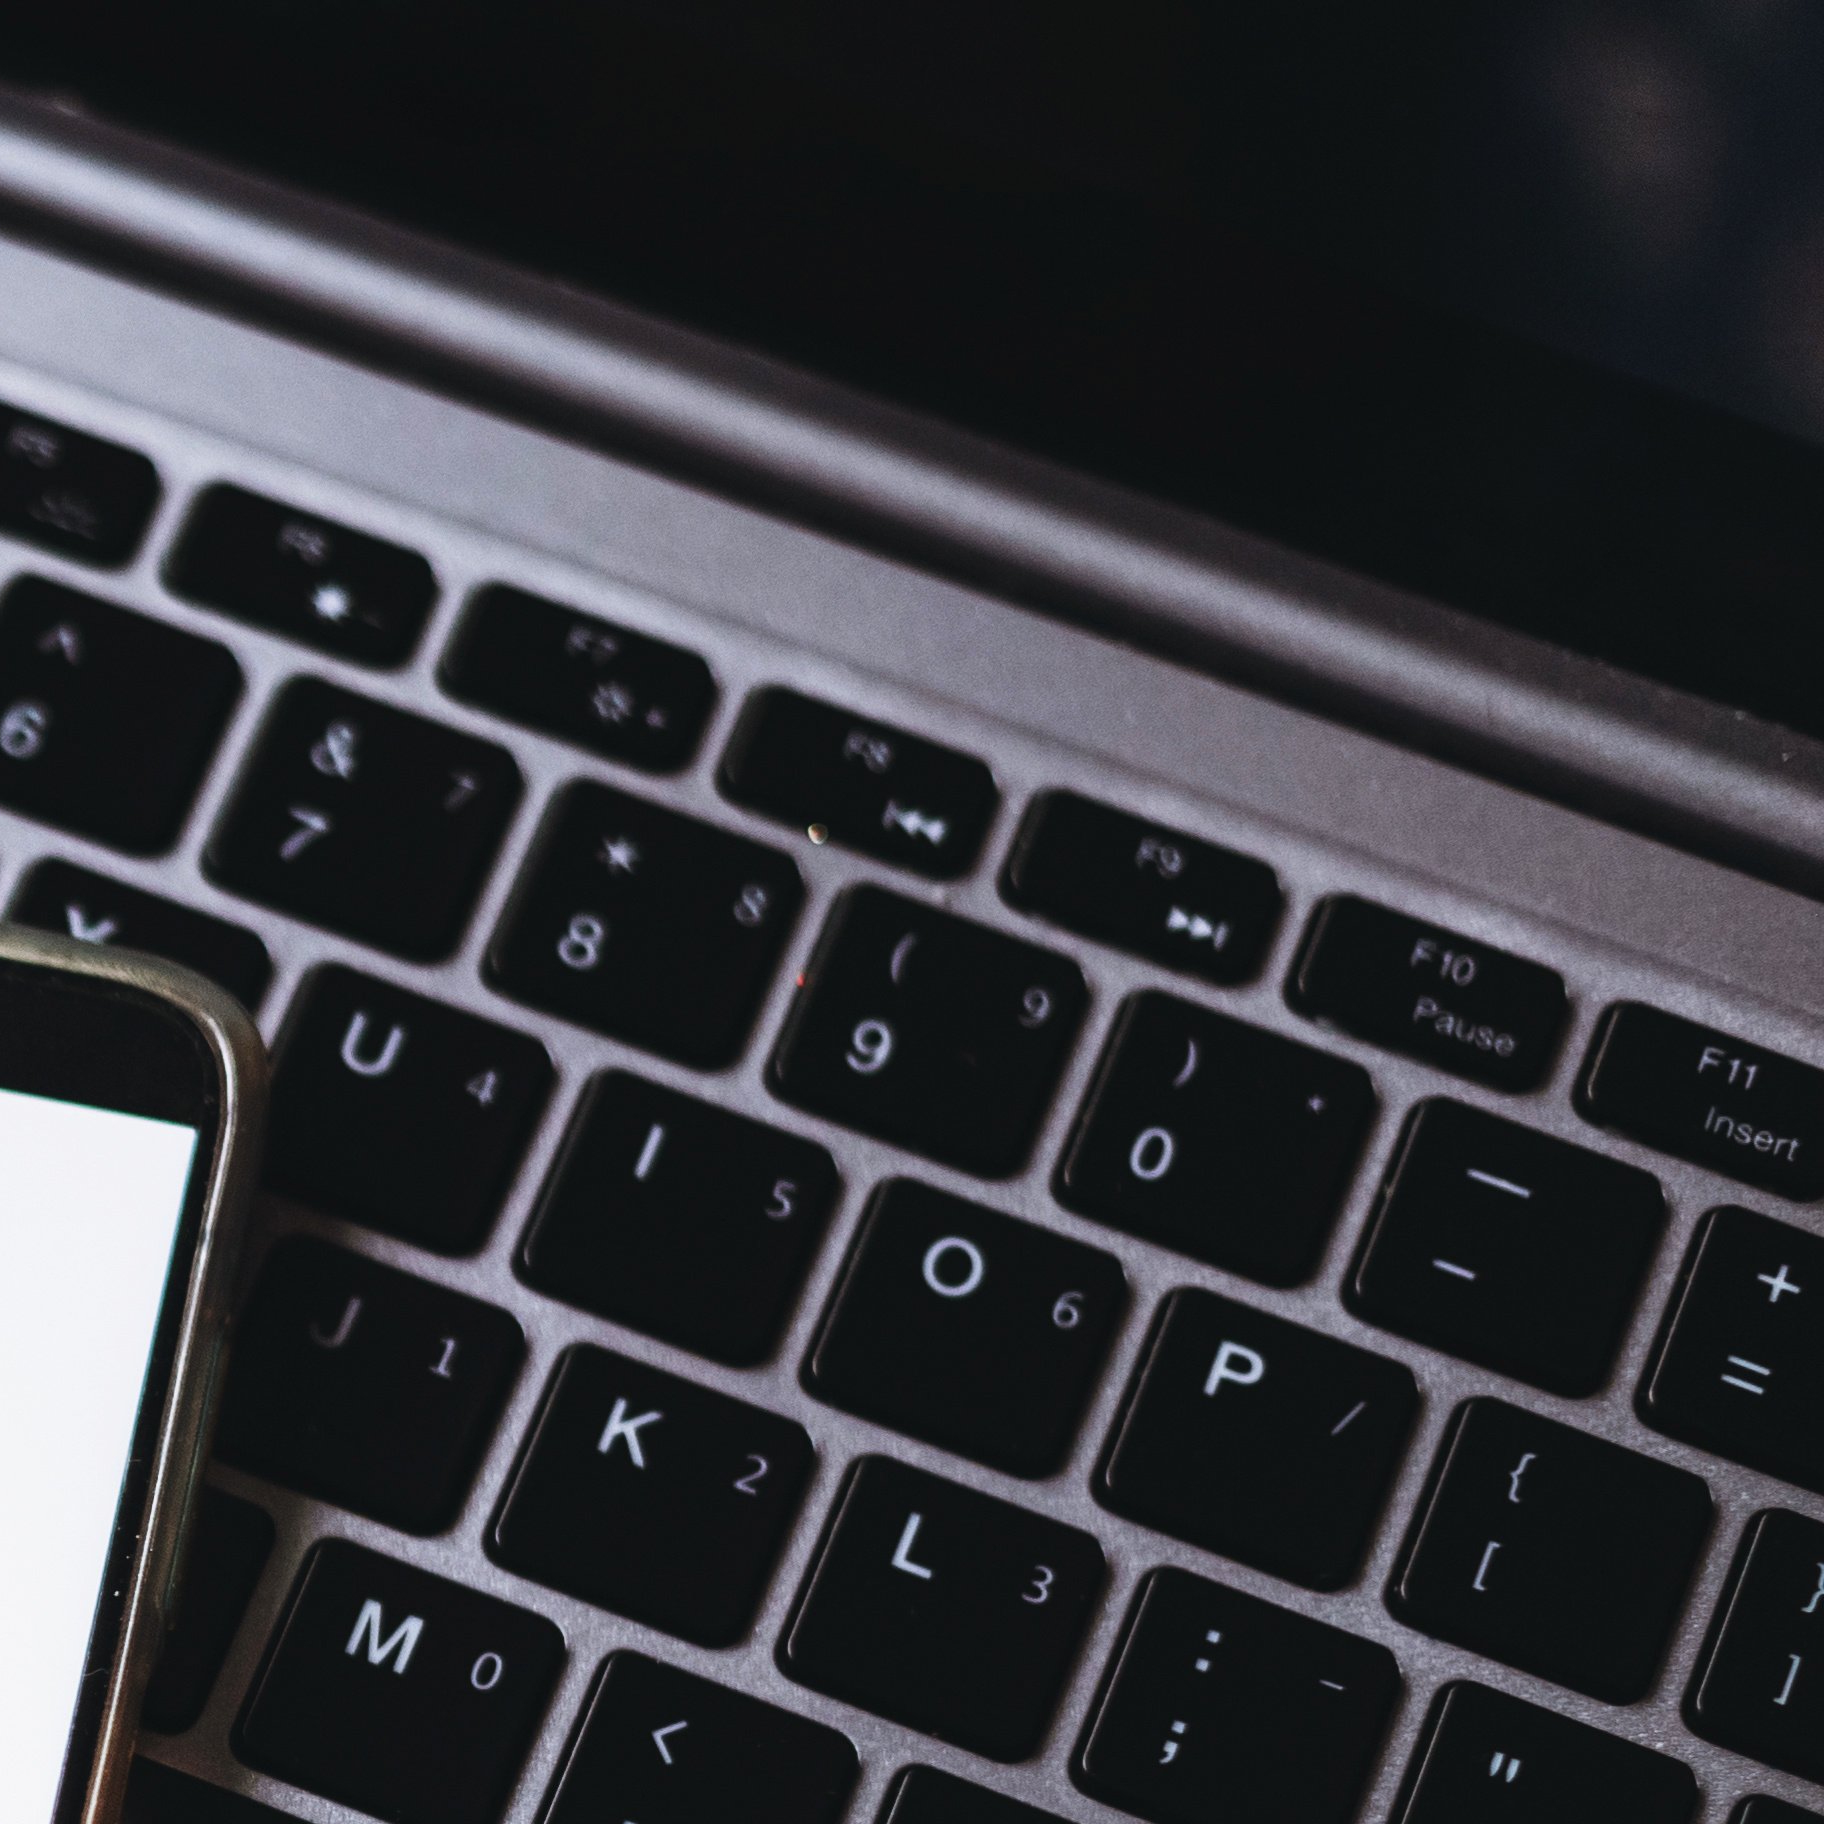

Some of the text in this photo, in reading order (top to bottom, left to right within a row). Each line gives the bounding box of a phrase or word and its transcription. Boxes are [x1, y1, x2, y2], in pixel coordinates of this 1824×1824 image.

[310, 723, 355, 779] &
[280, 807, 330, 859] 7
[1136, 837, 1185, 879] F9
[556, 914, 606, 970] 8
[889, 933, 916, 983] (
[1409, 937, 1478, 987] F10
[1022, 988, 1052, 1026] 9
[1410, 997, 1519, 1058] Pause
[340, 1011, 405, 1077] U
[845, 1018, 894, 1074] 9
[1174, 1039, 1199, 1087] )
[1696, 1044, 1759, 1092] F11
[466, 1070, 498, 1105] 4
[634, 1124, 665, 1180] I
[1129, 1126, 1176, 1181] 0
[1701, 1104, 1803, 1165] Insert
[766, 1179, 796, 1219] 5
[921, 1235, 985, 1298] O
[1757, 1264, 1801, 1303] +
[310, 1296, 364, 1349] J
[1051, 1290, 1084, 1329] 6
[430, 1337, 457, 1379] 1
[1203, 1340, 1266, 1397] P
[1720, 1355, 1772, 1396] =
[597, 1397, 662, 1469] K
[1330, 1400, 1367, 1436] /
[733, 1454, 770, 1496] 2
[1507, 1452, 1537, 1504] {
[891, 1512, 933, 1580] L
[1472, 1540, 1502, 1592] [
[1021, 1564, 1055, 1605] 3
[345, 1598, 425, 1675] M
[1194, 1629, 1222, 1673] :
[1772, 1653, 1802, 1706] ]
[651, 1720, 688, 1765] <
[1159, 1720, 1187, 1765] ;
[1489, 1751, 1522, 1783] "
